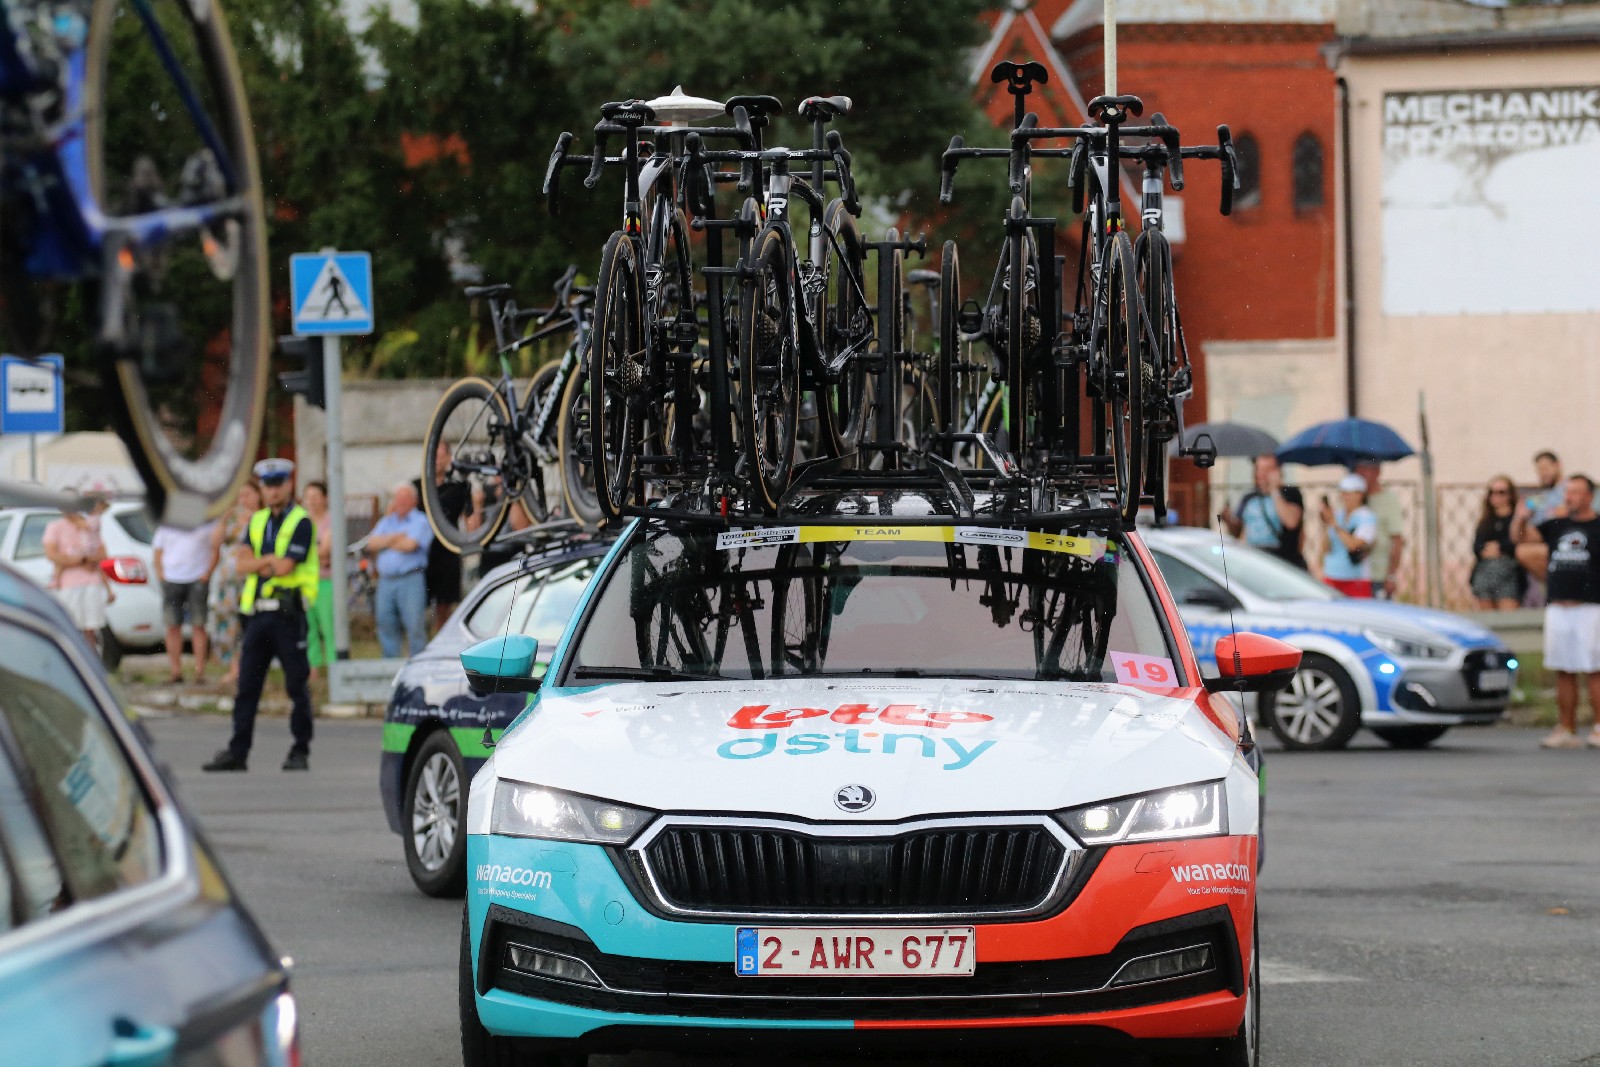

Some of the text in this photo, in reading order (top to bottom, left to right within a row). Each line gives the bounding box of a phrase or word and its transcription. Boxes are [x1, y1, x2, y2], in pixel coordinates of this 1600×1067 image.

[1045, 538, 1076, 548] 219
[1121, 660, 1169, 683] 19
[716, 729, 998, 771] dstny
[476, 864, 552, 889] wanacom
[1170, 863, 1250, 882] wanacom
[1187, 887, 1201, 895] Your
[1201, 886, 1211, 894] Car
[762, 935, 968, 969] 2-AWR-677
[742, 955, 755, 971] B
